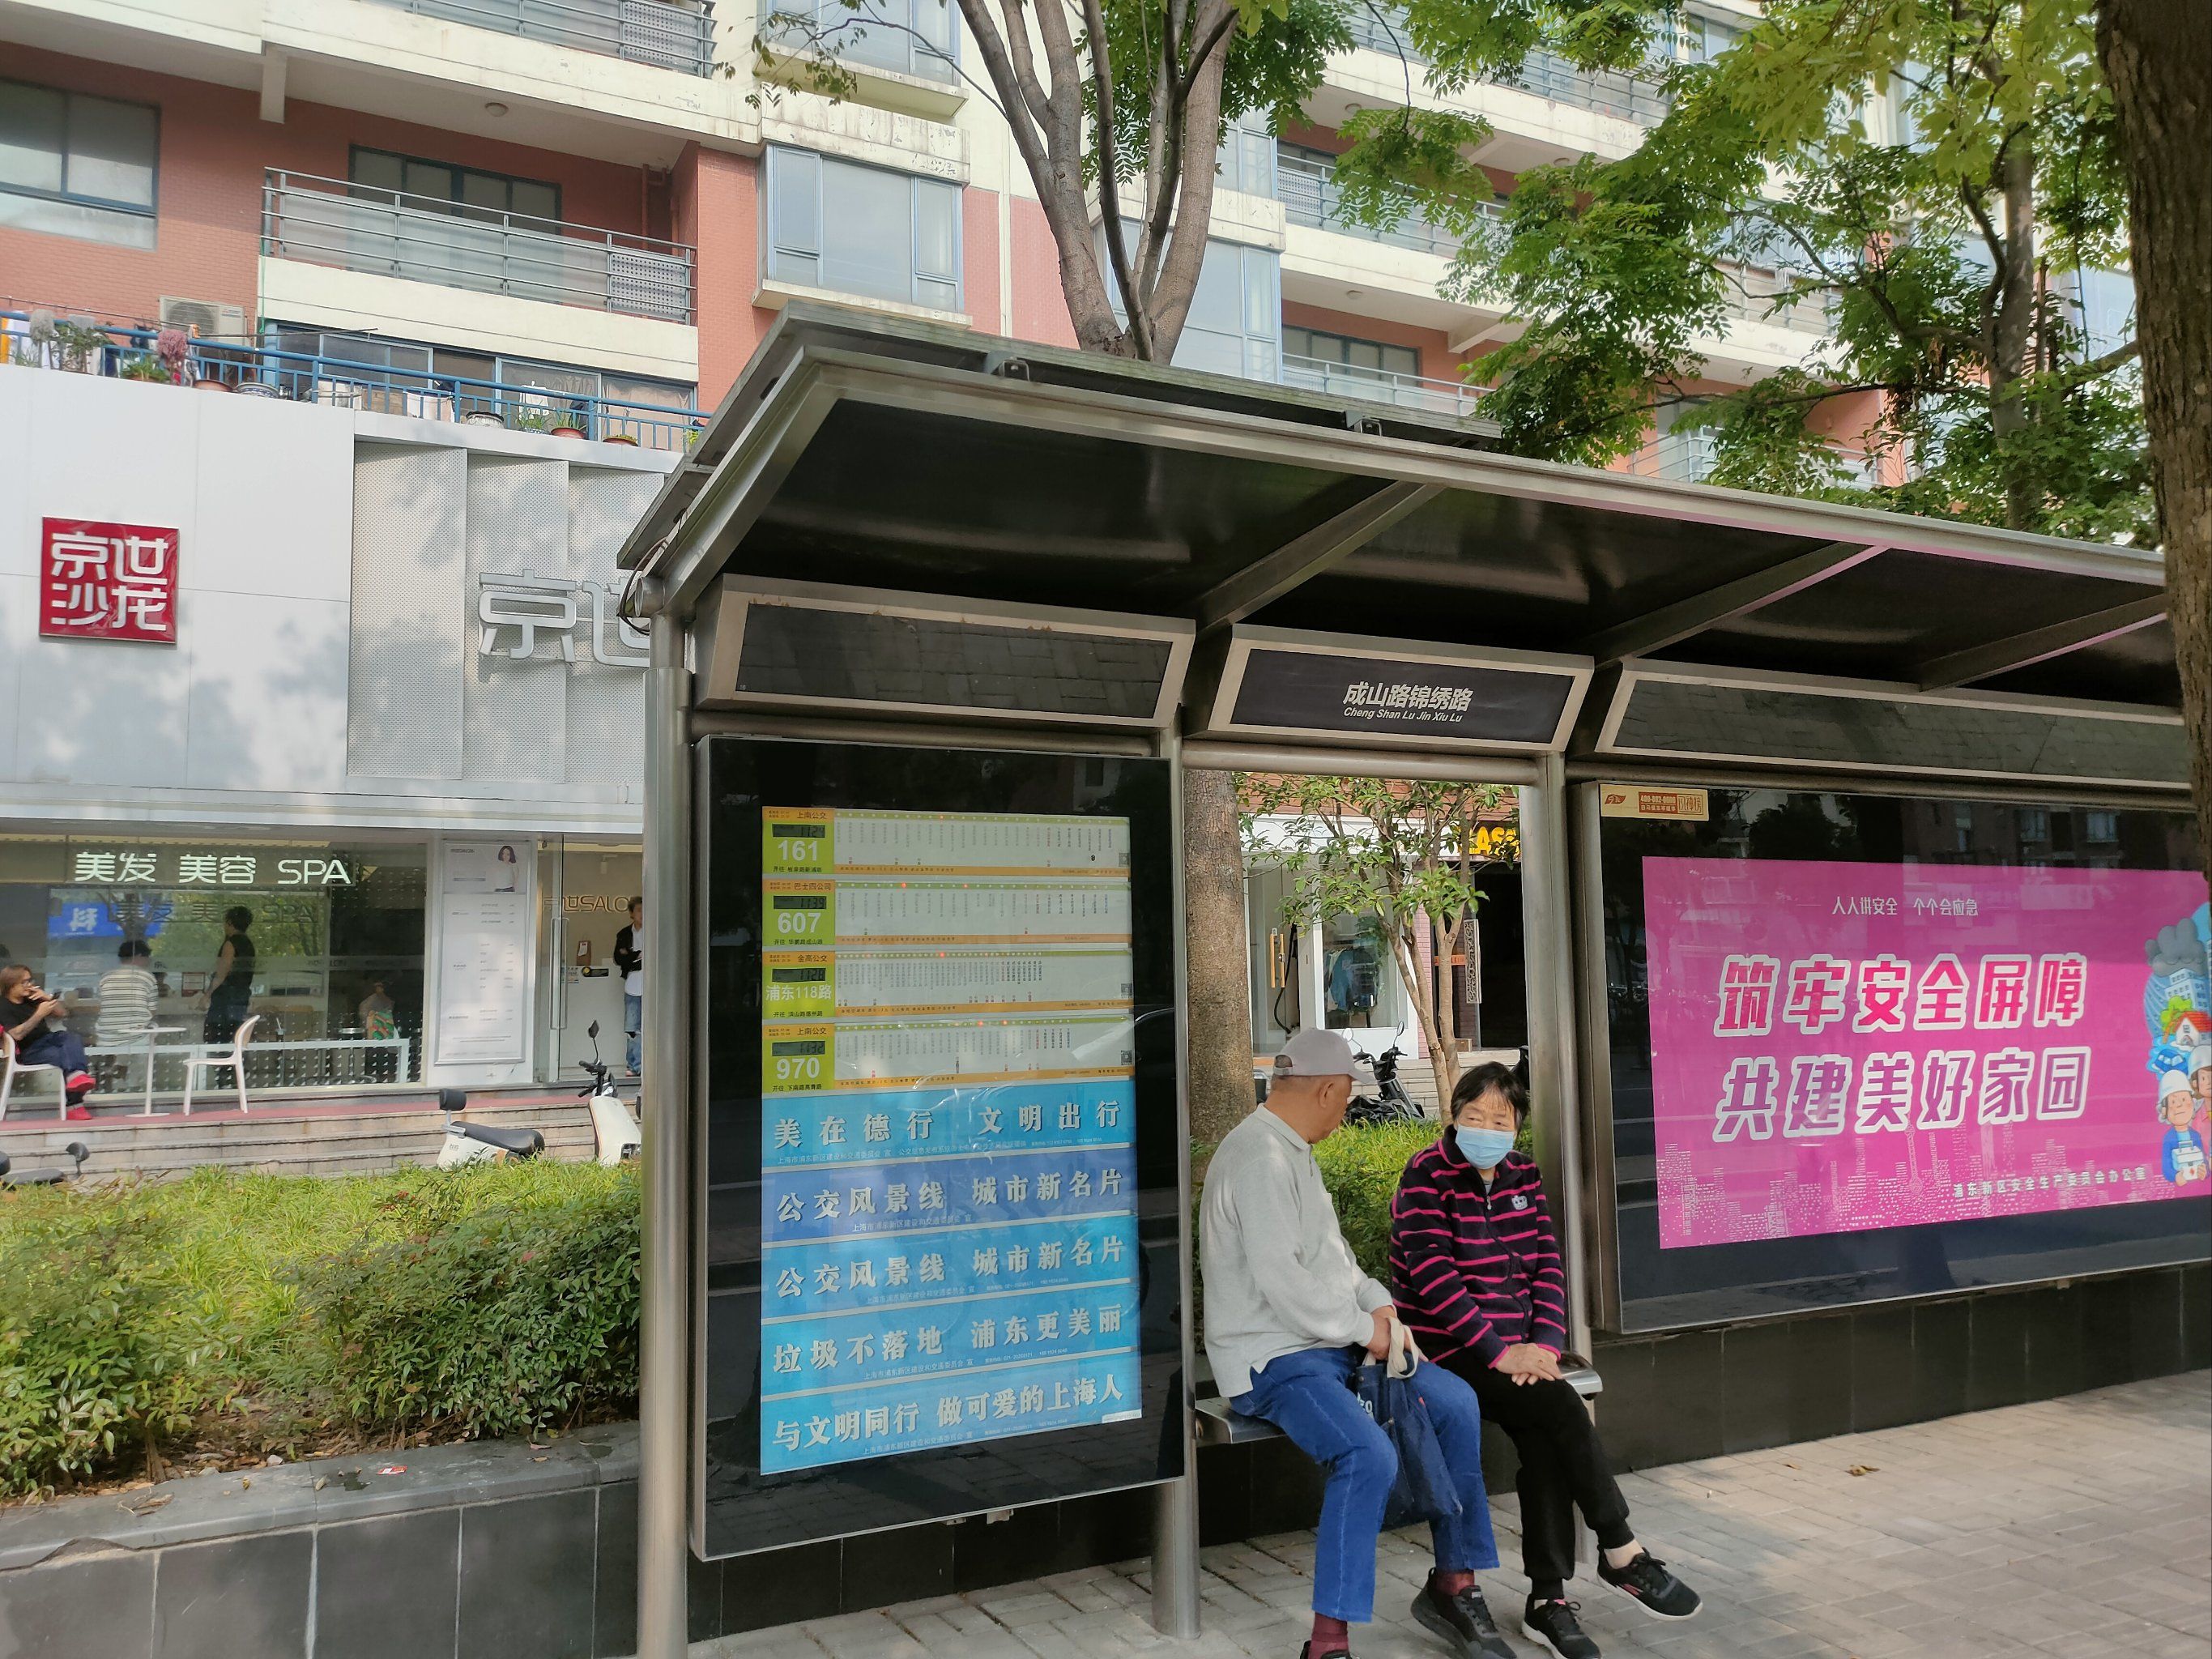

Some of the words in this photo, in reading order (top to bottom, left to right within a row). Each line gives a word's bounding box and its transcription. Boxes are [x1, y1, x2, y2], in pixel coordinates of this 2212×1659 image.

[51, 531, 168, 586] 京世
[1342, 680, 1474, 712] 成山路锦绣路
[1343, 706, 1375, 719] Cheng
[1377, 709, 1401, 719] Shan
[1402, 710, 1416, 720] Lu
[1417, 710, 1431, 721] Jin
[1432, 711, 1449, 722] Xiu
[1449, 713, 1463, 723] Lu
[778, 839, 818, 861] 161
[75, 852, 157, 882] 美发
[179, 854, 256, 884] 美容
[278, 859, 352, 885] SPA
[1831, 896, 1898, 915] 人人讲安全
[1913, 898, 1979, 916] 个个会应急
[778, 912, 821, 934] 607
[765, 984, 832, 1001] 浦东118路
[1714, 953, 2088, 1037] 筑牢安全屏障
[777, 1057, 820, 1080] 970
[1713, 1047, 2091, 1142] 共建美好家园
[773, 1109, 934, 1149] 美在德行
[977, 1098, 1123, 1136] 文明出行
[776, 1181, 946, 1224] 公交风景线
[972, 1167, 1123, 1207] 城市新名片
[1953, 1166, 2146, 1198] 浦东新区安全生产委员会办公室
[776, 1253, 946, 1299] 公交风景线
[972, 1234, 1125, 1277] 城市新名片
[773, 1325, 944, 1375] 垃圾不落地
[971, 1303, 1122, 1349] 浦东更美丽
[772, 1402, 921, 1452] 与文明同行
[936, 1372, 1124, 1427] 做可爱的上海人
